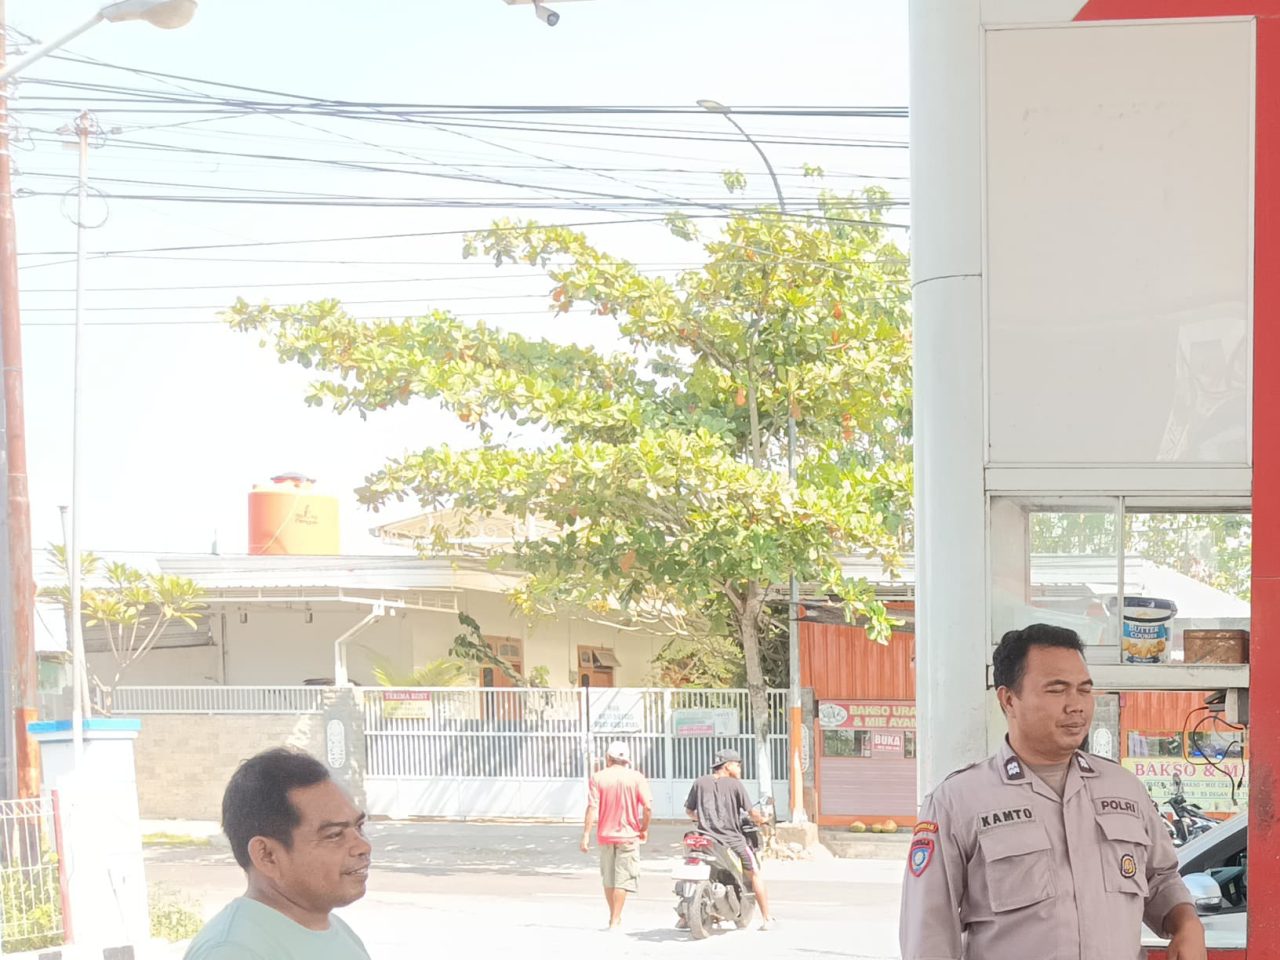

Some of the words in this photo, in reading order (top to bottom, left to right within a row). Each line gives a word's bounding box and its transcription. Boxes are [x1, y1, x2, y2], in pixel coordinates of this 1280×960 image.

[849, 705, 890, 716] BAKSO
[853, 717, 863, 727] &
[864, 717, 888, 727] MIE
[874, 735, 901, 746] BUKA
[1135, 763, 1196, 777] BAKSO
[1203, 763, 1215, 777] &
[1101, 800, 1136, 813] POLRI
[981, 808, 1033, 828] KAMTO
